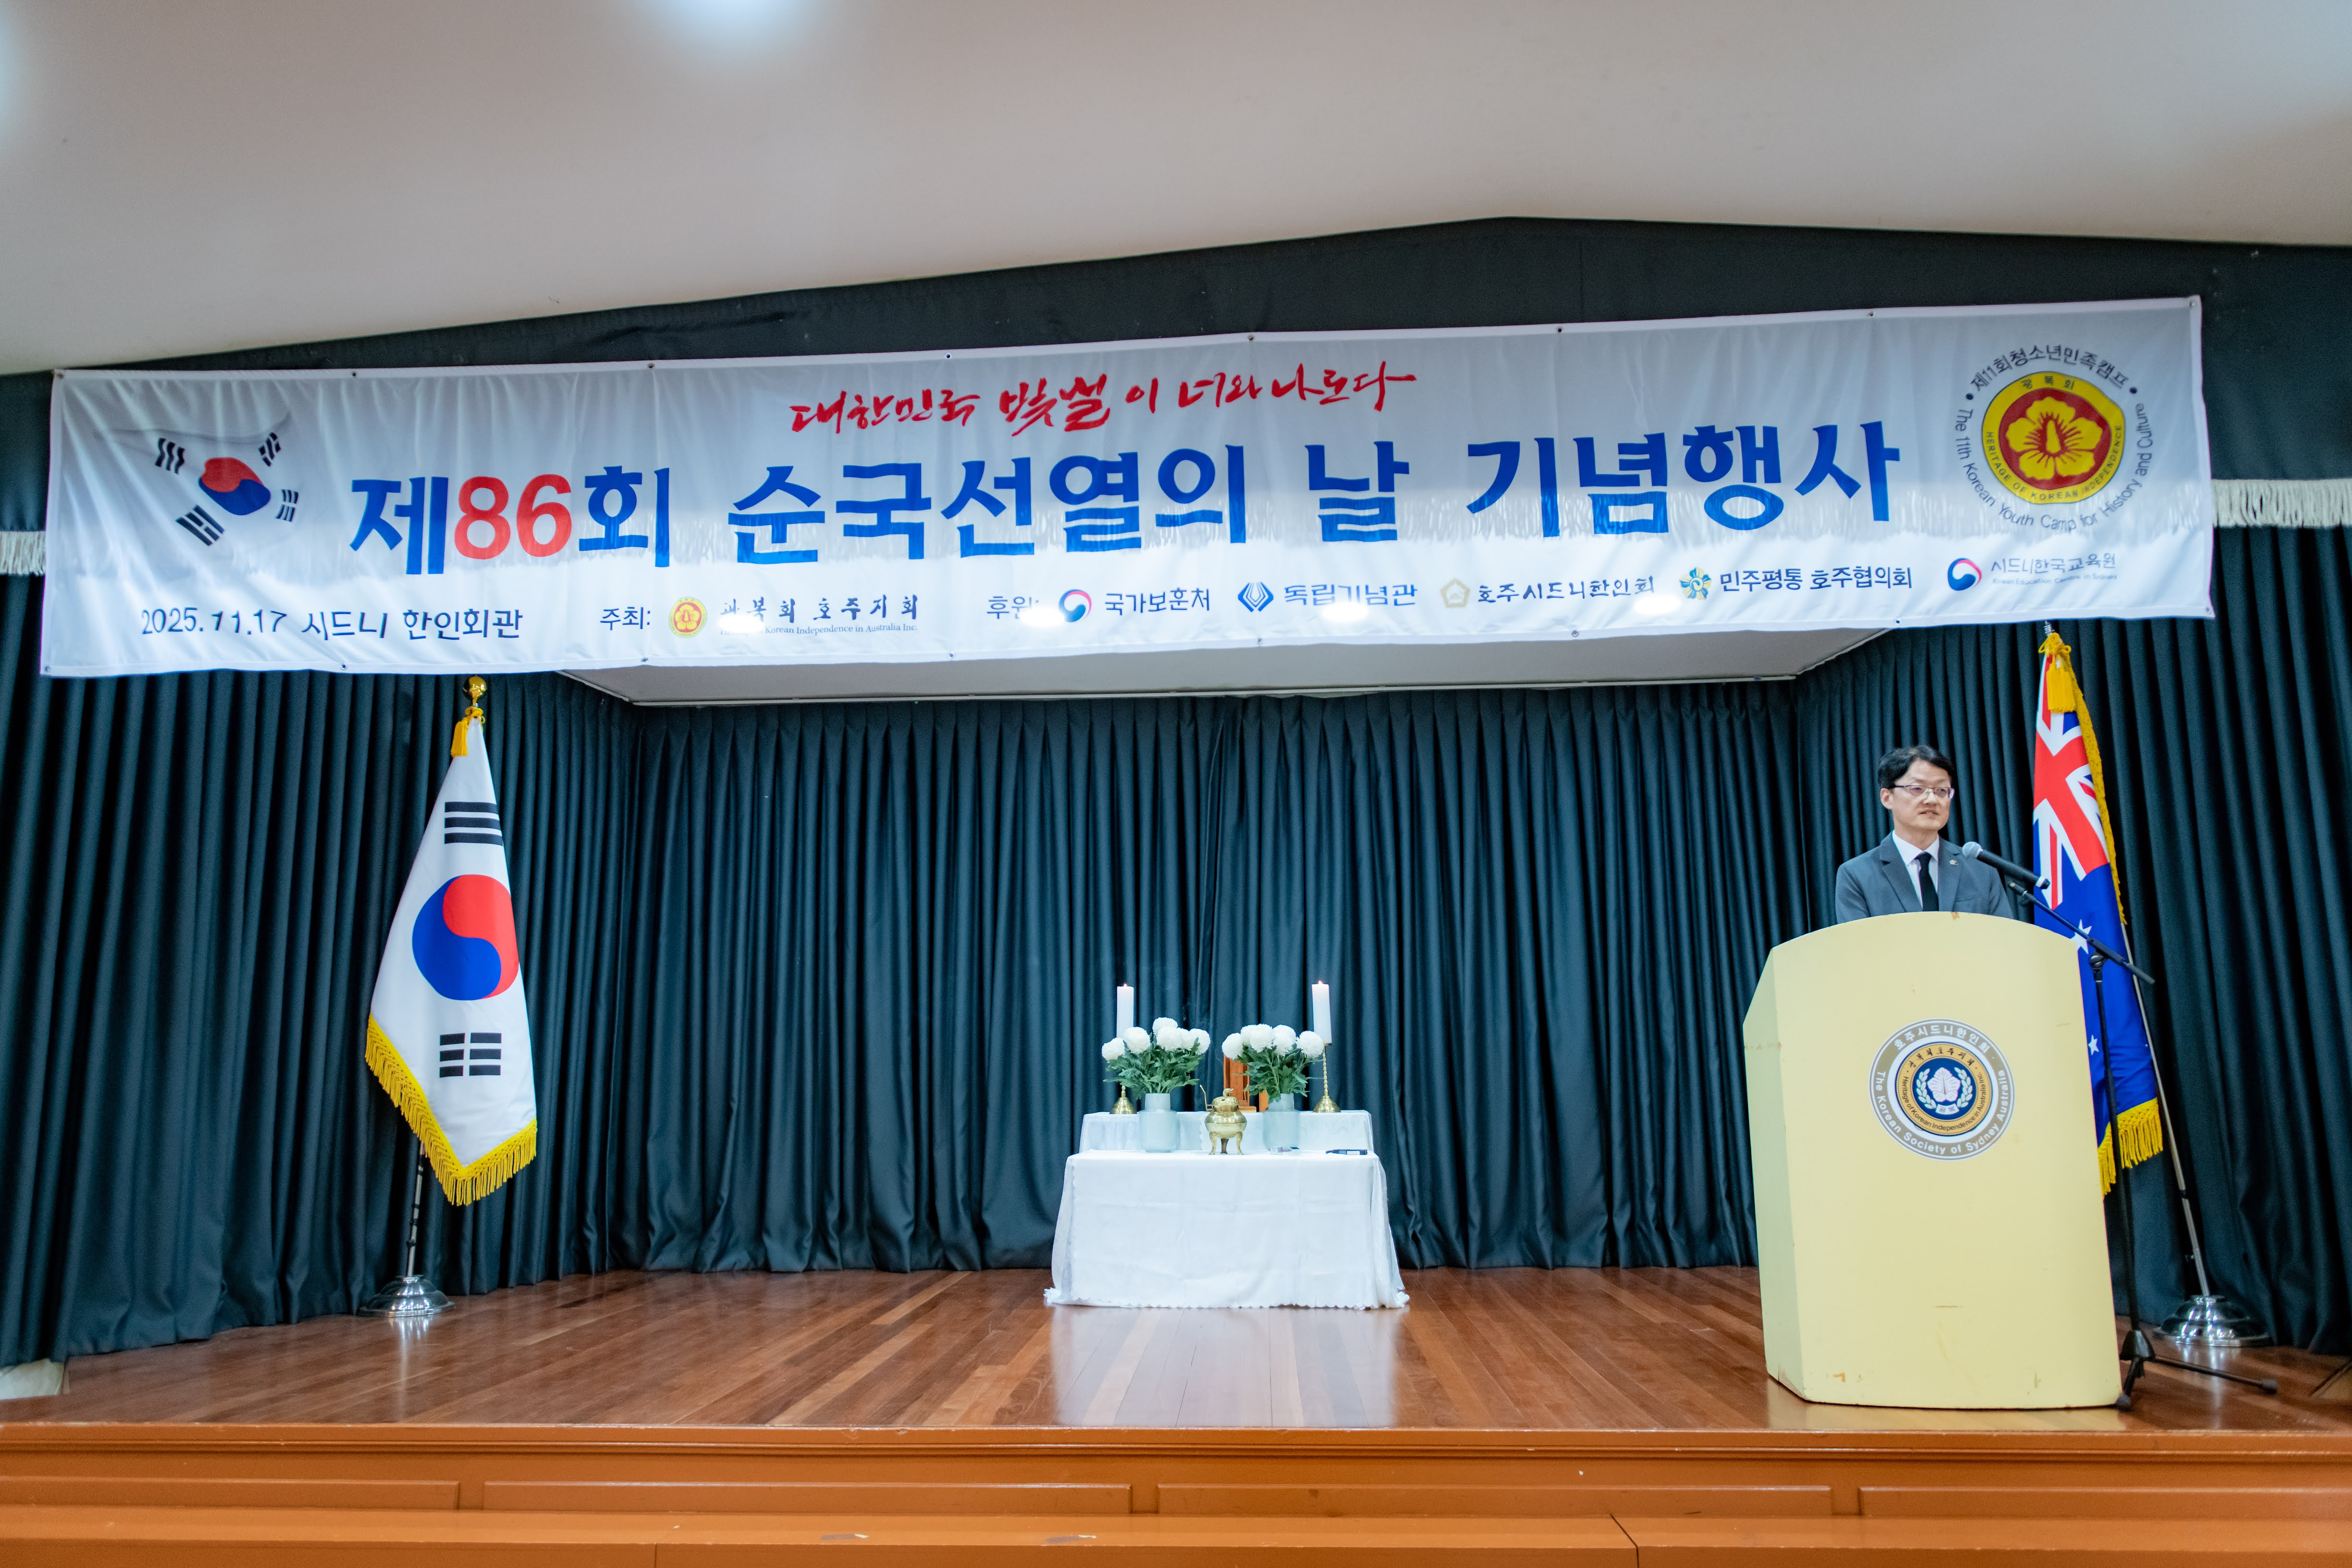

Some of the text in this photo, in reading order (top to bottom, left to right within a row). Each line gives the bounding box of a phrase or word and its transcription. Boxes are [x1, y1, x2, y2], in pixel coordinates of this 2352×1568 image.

[789, 389, 981, 434] 대한민국
[1178, 372, 1263, 408] 너와
[1272, 361, 1417, 412] 나로다
[1955, 403, 2153, 532] The 11th Korean Youth Camp for History and Culture
[1986, 425, 2122, 500] HERITAGE OF KOREAN INDEPENDENCE
[350, 420, 1900, 575] 제86회 순국선열의 날 기념행사
[1720, 565, 1913, 591] 민주평통 호주협의회
[1991, 553, 2116, 574] 시드니한국교육원
[1105, 587, 1210, 615] 국가보훈처
[1285, 583, 1418, 606] 독립기념관
[1478, 575, 1655, 603] 호주시드니한인회
[141, 607, 523, 640] 2025.11.17 시드니 한인회관
[599, 606, 650, 630] 주최:
[797, 625, 853, 636] Independence
[865, 623, 901, 632] Australia
[1894, 1025, 1990, 1054] 호주시드니한인회
[1875, 1070, 2009, 1155] The Korean Society of Sydney Australia
[1911, 1109, 1932, 1127] Korean
[1932, 1116, 1976, 1132] Independence
[1977, 1084, 1987, 1112] Australia
